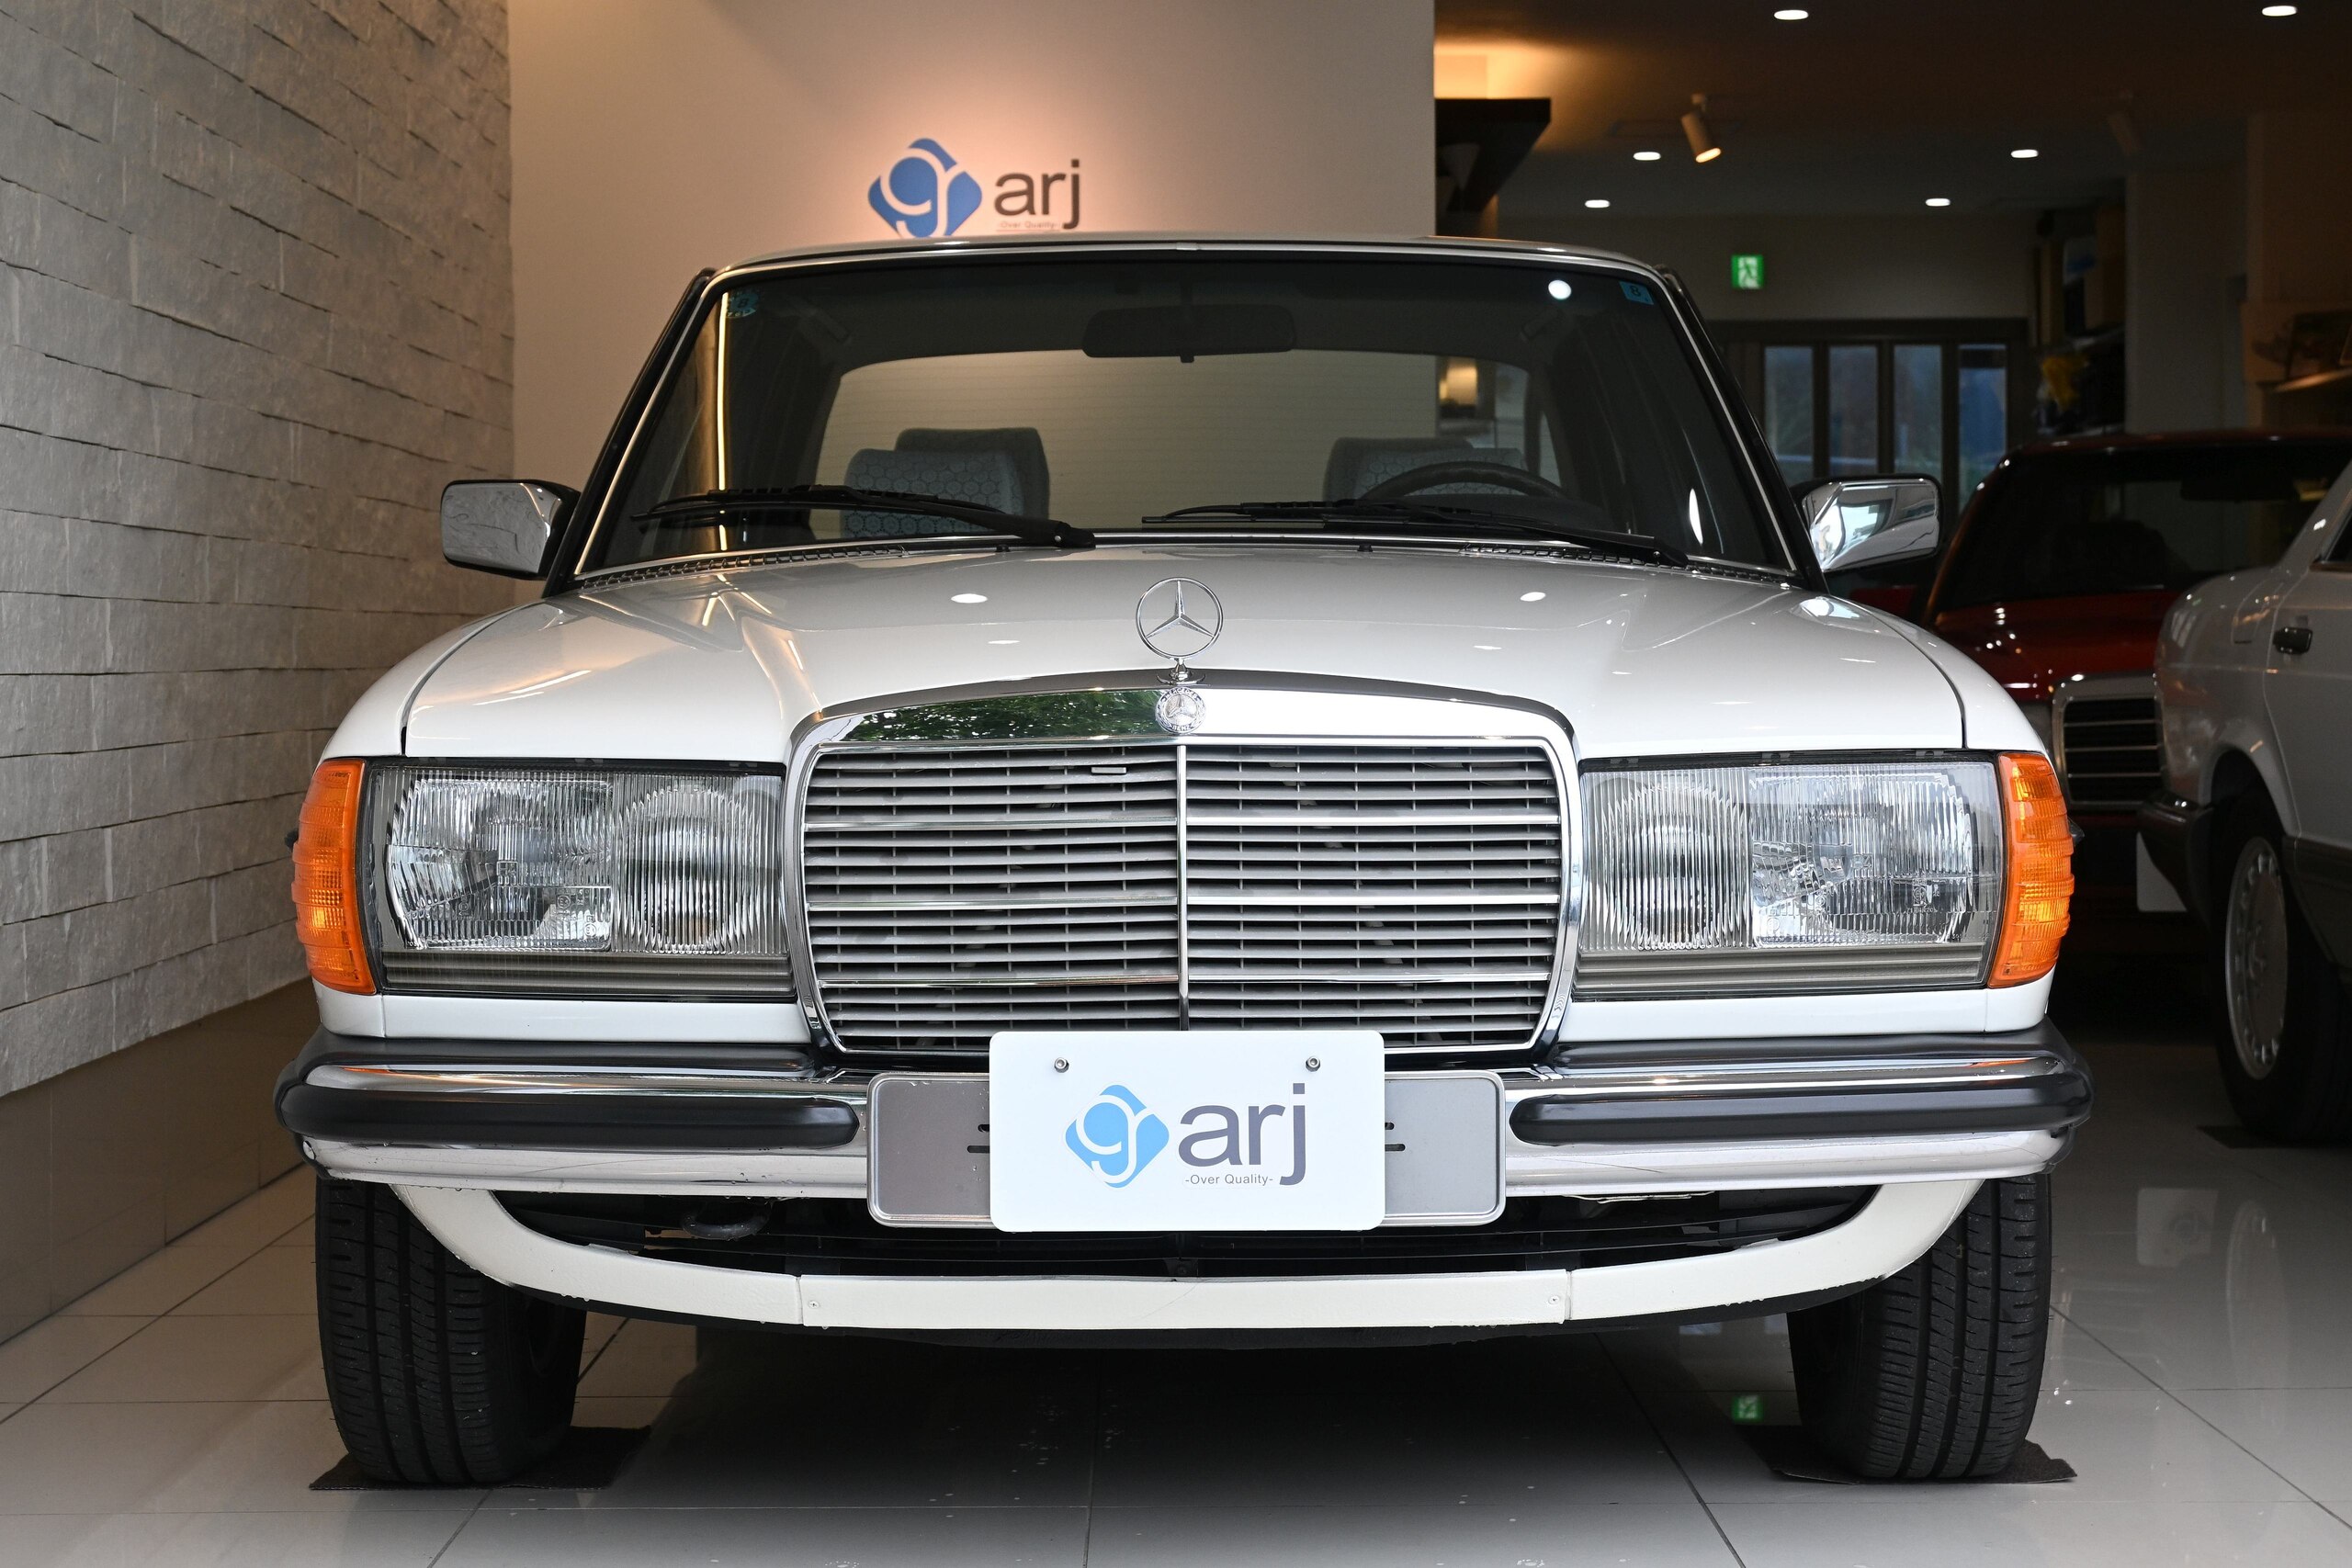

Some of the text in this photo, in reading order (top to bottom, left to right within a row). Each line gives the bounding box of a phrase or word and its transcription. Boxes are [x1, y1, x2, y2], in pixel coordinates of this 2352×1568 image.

[994, 158, 1080, 230] arj
[1179, 1082, 1306, 1186] arj
[1184, 1173, 1274, 1186] -Over Quality-
